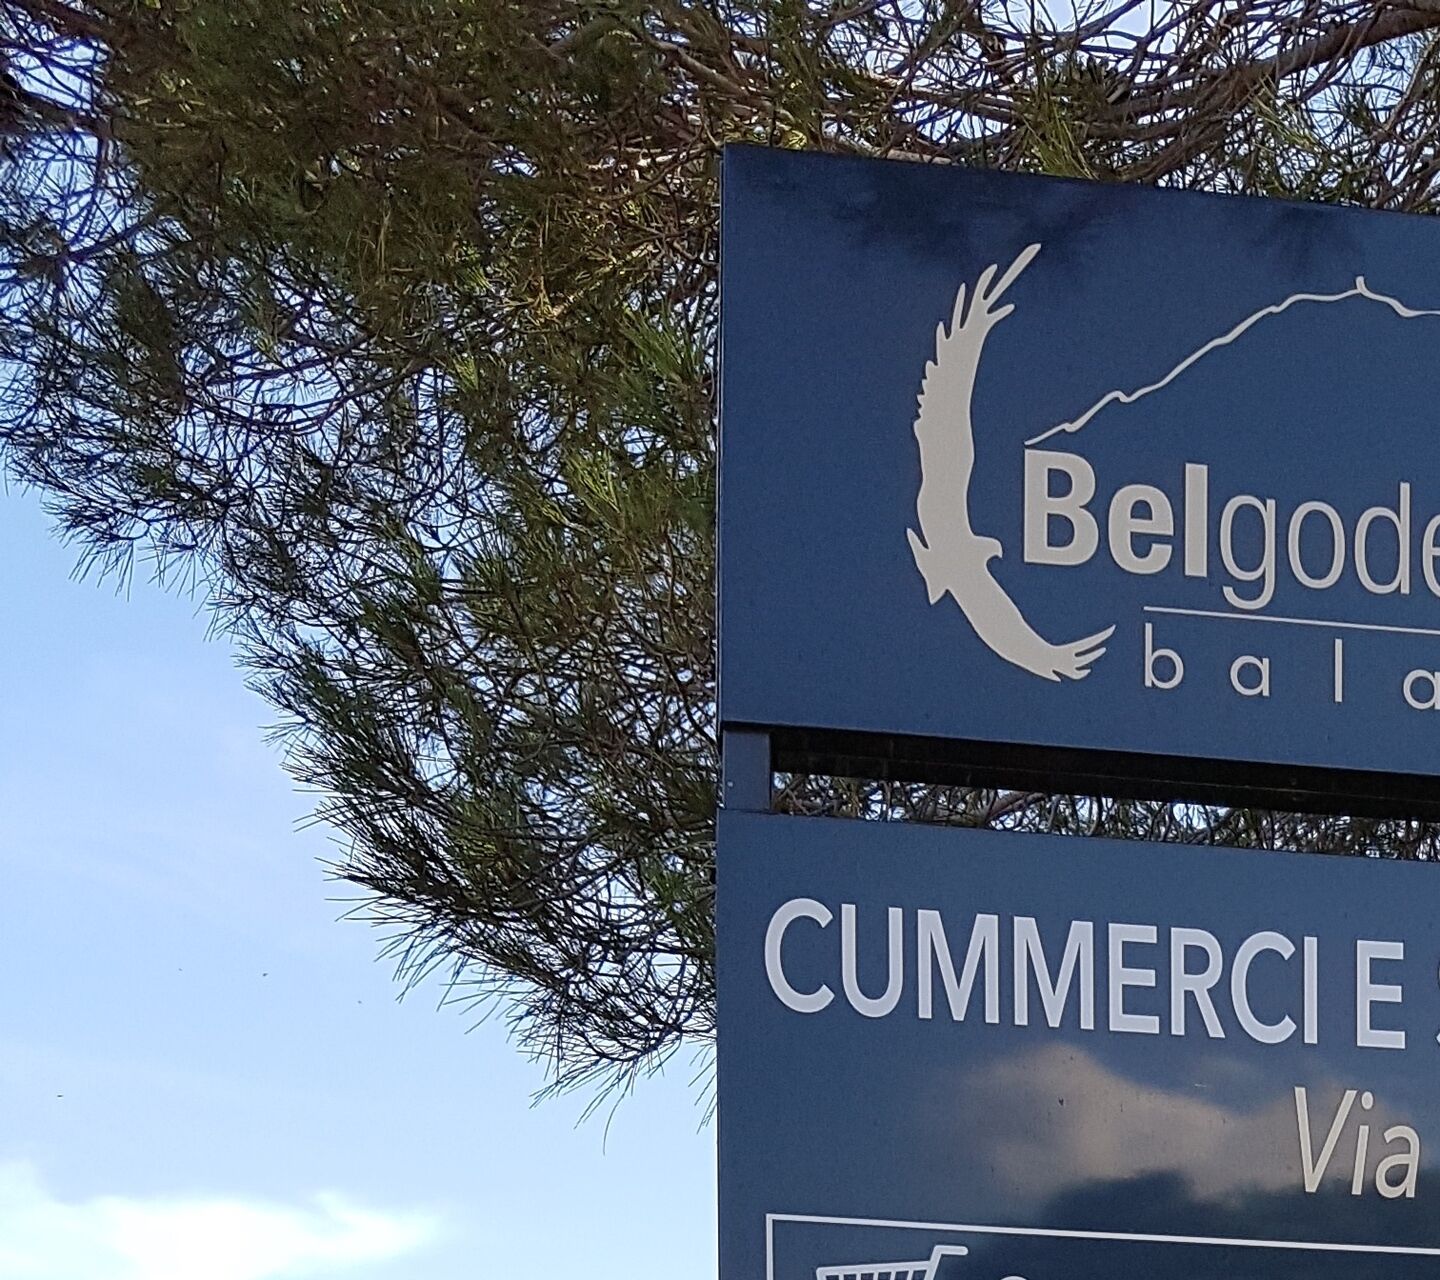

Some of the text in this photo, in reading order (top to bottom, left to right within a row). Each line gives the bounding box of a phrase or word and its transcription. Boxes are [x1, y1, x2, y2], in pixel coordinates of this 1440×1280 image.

[764, 898, 1318, 1046] CUMMERCI
[1356, 939, 1406, 1050] E
[1294, 1086, 1420, 1198] Via
